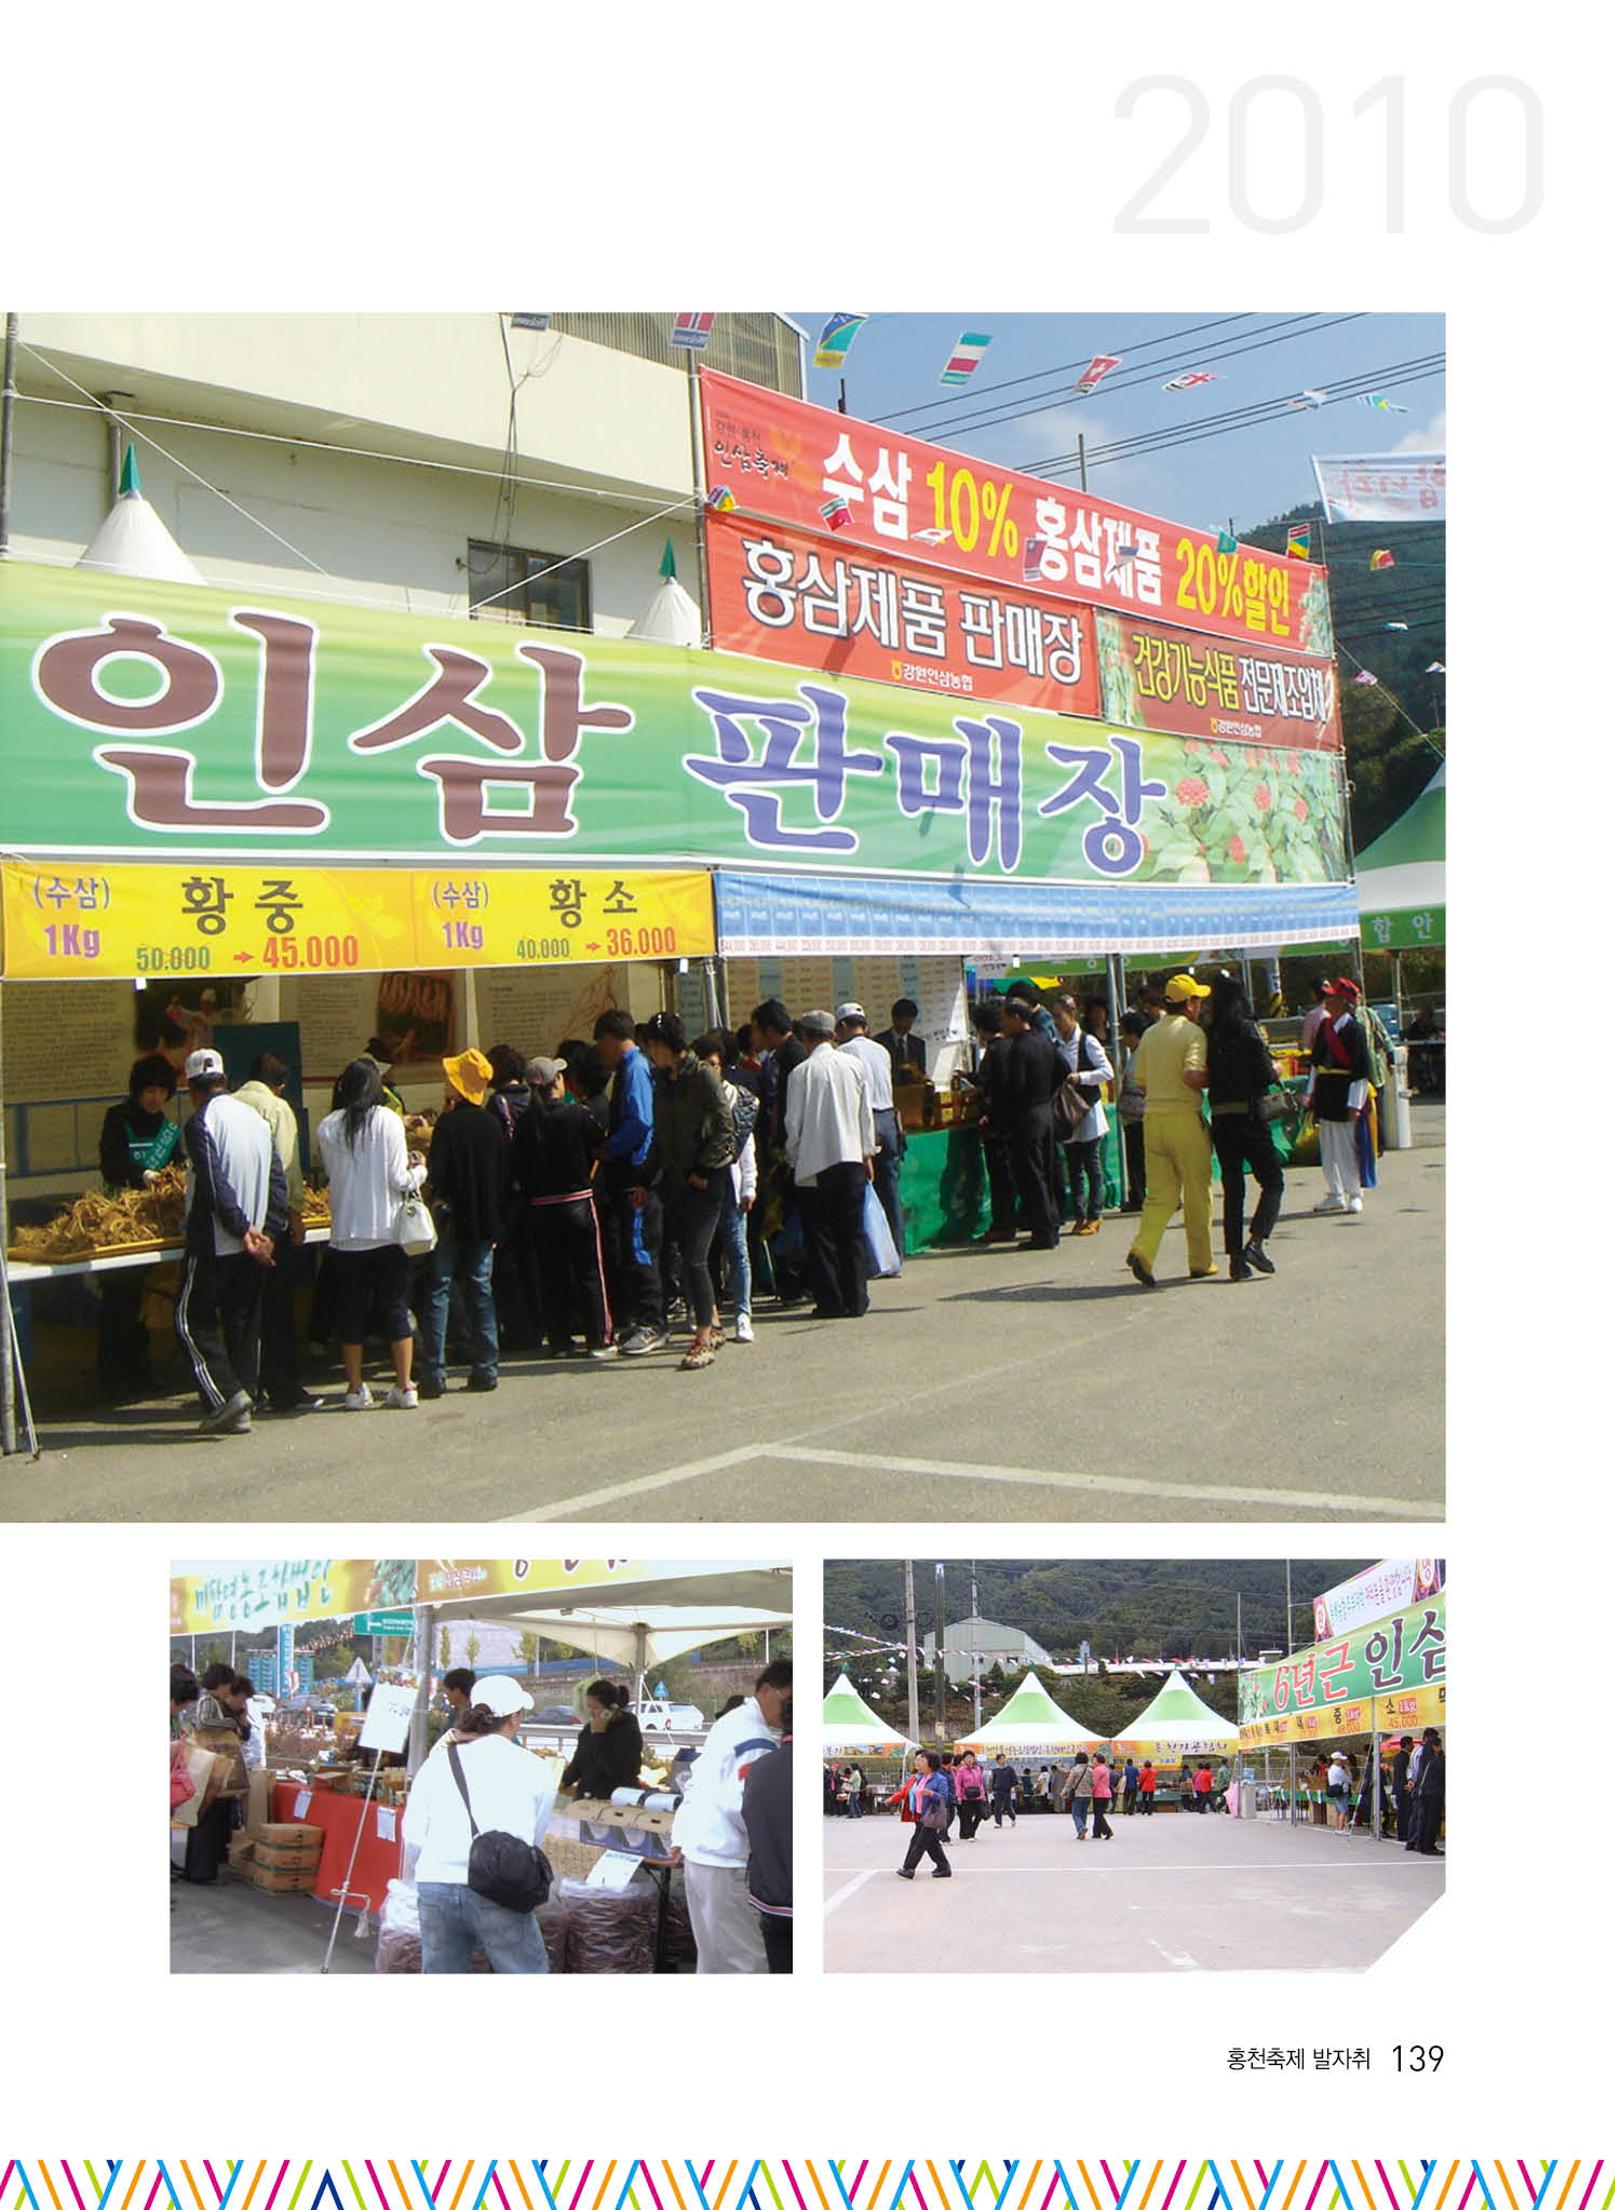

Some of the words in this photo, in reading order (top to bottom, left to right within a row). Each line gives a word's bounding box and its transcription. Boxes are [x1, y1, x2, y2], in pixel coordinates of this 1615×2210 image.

[822, 432, 913, 541] 수삼
[926, 461, 1019, 558] 10%
[1034, 496, 1163, 607] 홍삼제품
[741, 537, 948, 658] 홍삼제품
[957, 588, 1083, 689] 판매장
[903, 663, 973, 691] 강원인삼농협
[1131, 632, 1240, 711] 건강기능식품
[1238, 656, 1328, 722] 전문제조업체
[32, 609, 635, 847] 인삼
[681, 684, 1169, 878] 판매장
[32, 875, 112, 911] (수삼)
[432, 880, 489, 910] (수삼)
[43, 922, 101, 960] 1Kg
[262, 934, 360, 969] 45.000
[442, 920, 485, 950] 1Kg
[605, 926, 678, 957] 36.000
[1273, 1640, 1356, 1711] 6년근
